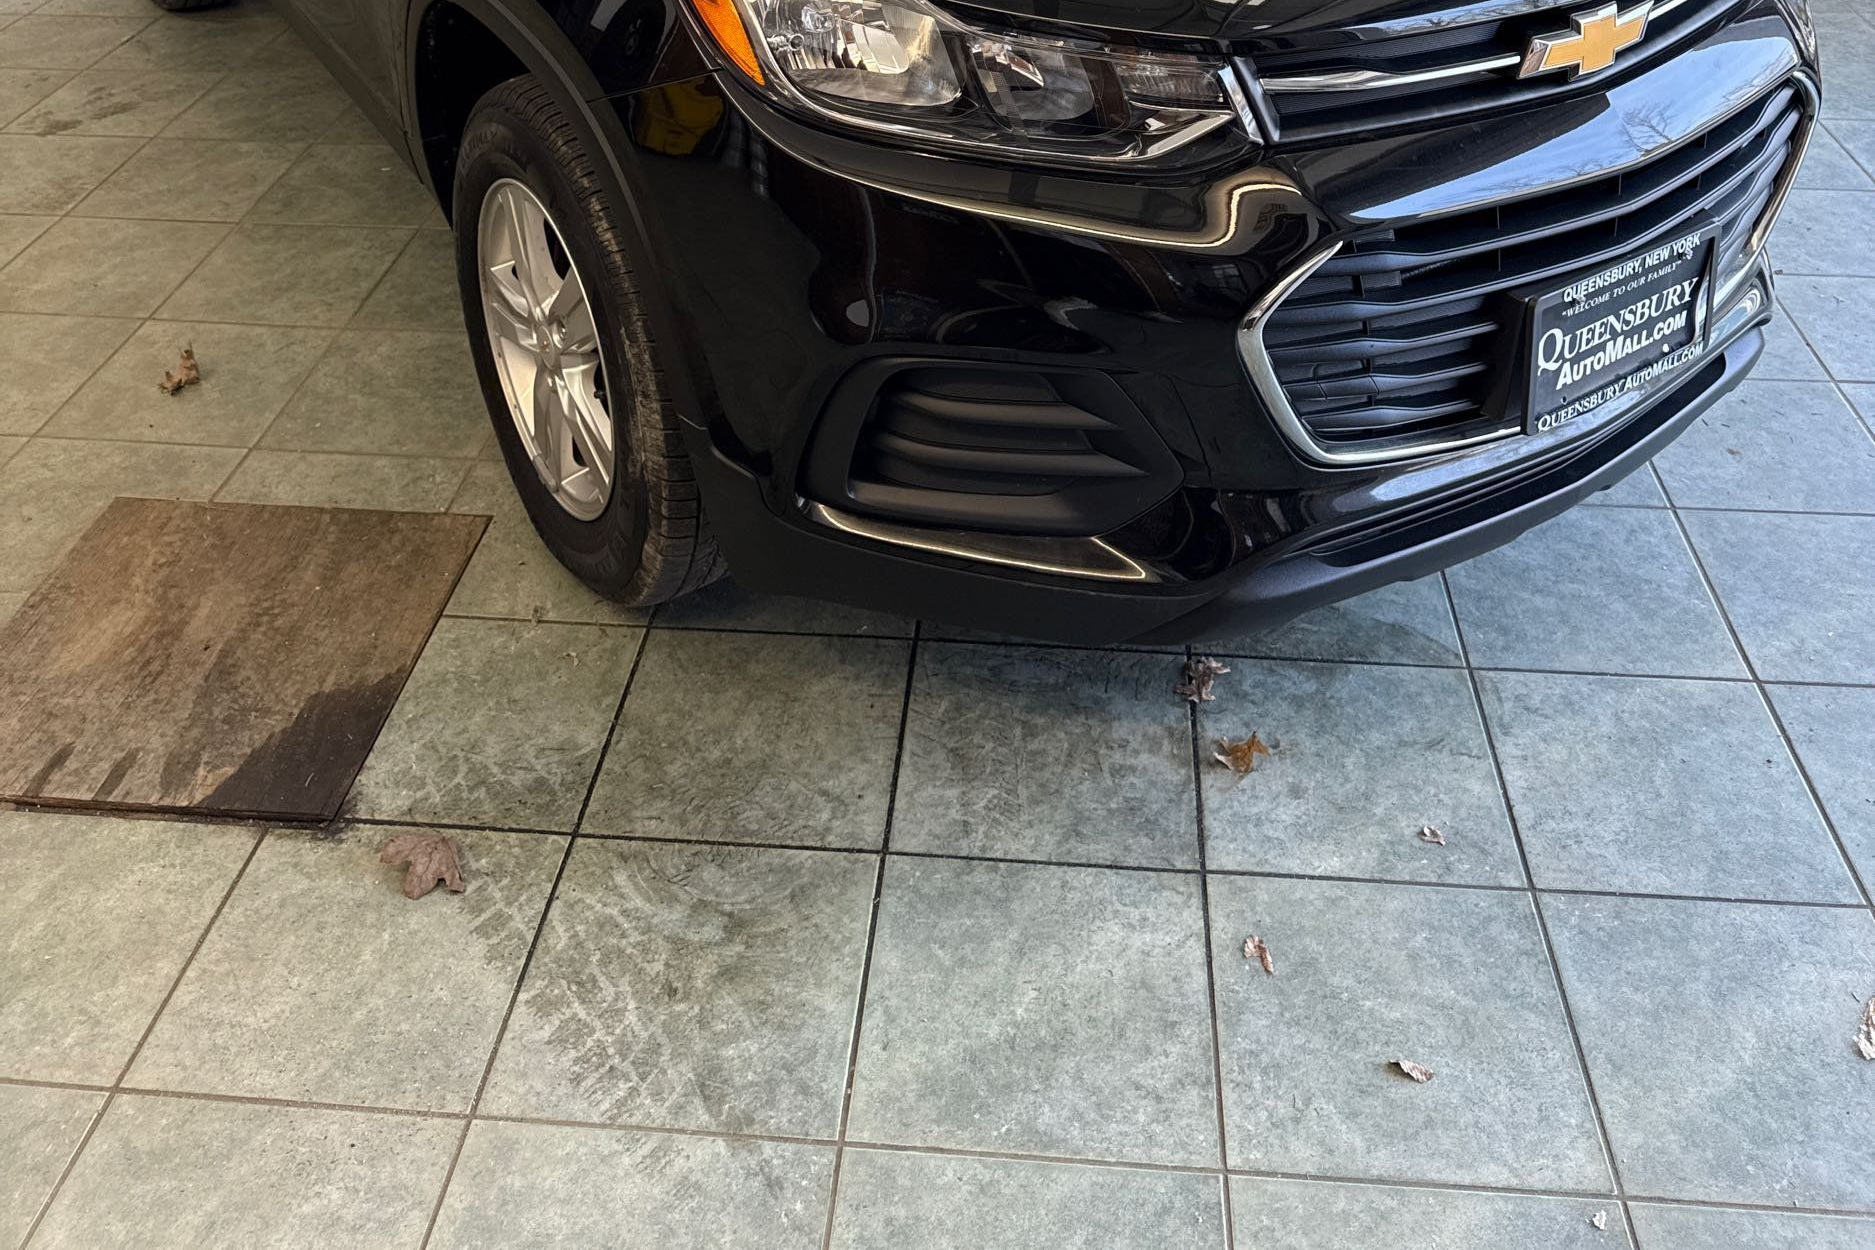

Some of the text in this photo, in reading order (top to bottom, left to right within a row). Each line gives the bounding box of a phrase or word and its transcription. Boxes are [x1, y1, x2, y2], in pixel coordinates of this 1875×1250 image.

[1563, 232, 1701, 303] QUEENSBURY, NEW YORK
[1612, 285, 1626, 298] TO
[1626, 276, 1646, 291] OUR
[1537, 276, 1699, 377] QUEENSBURY
